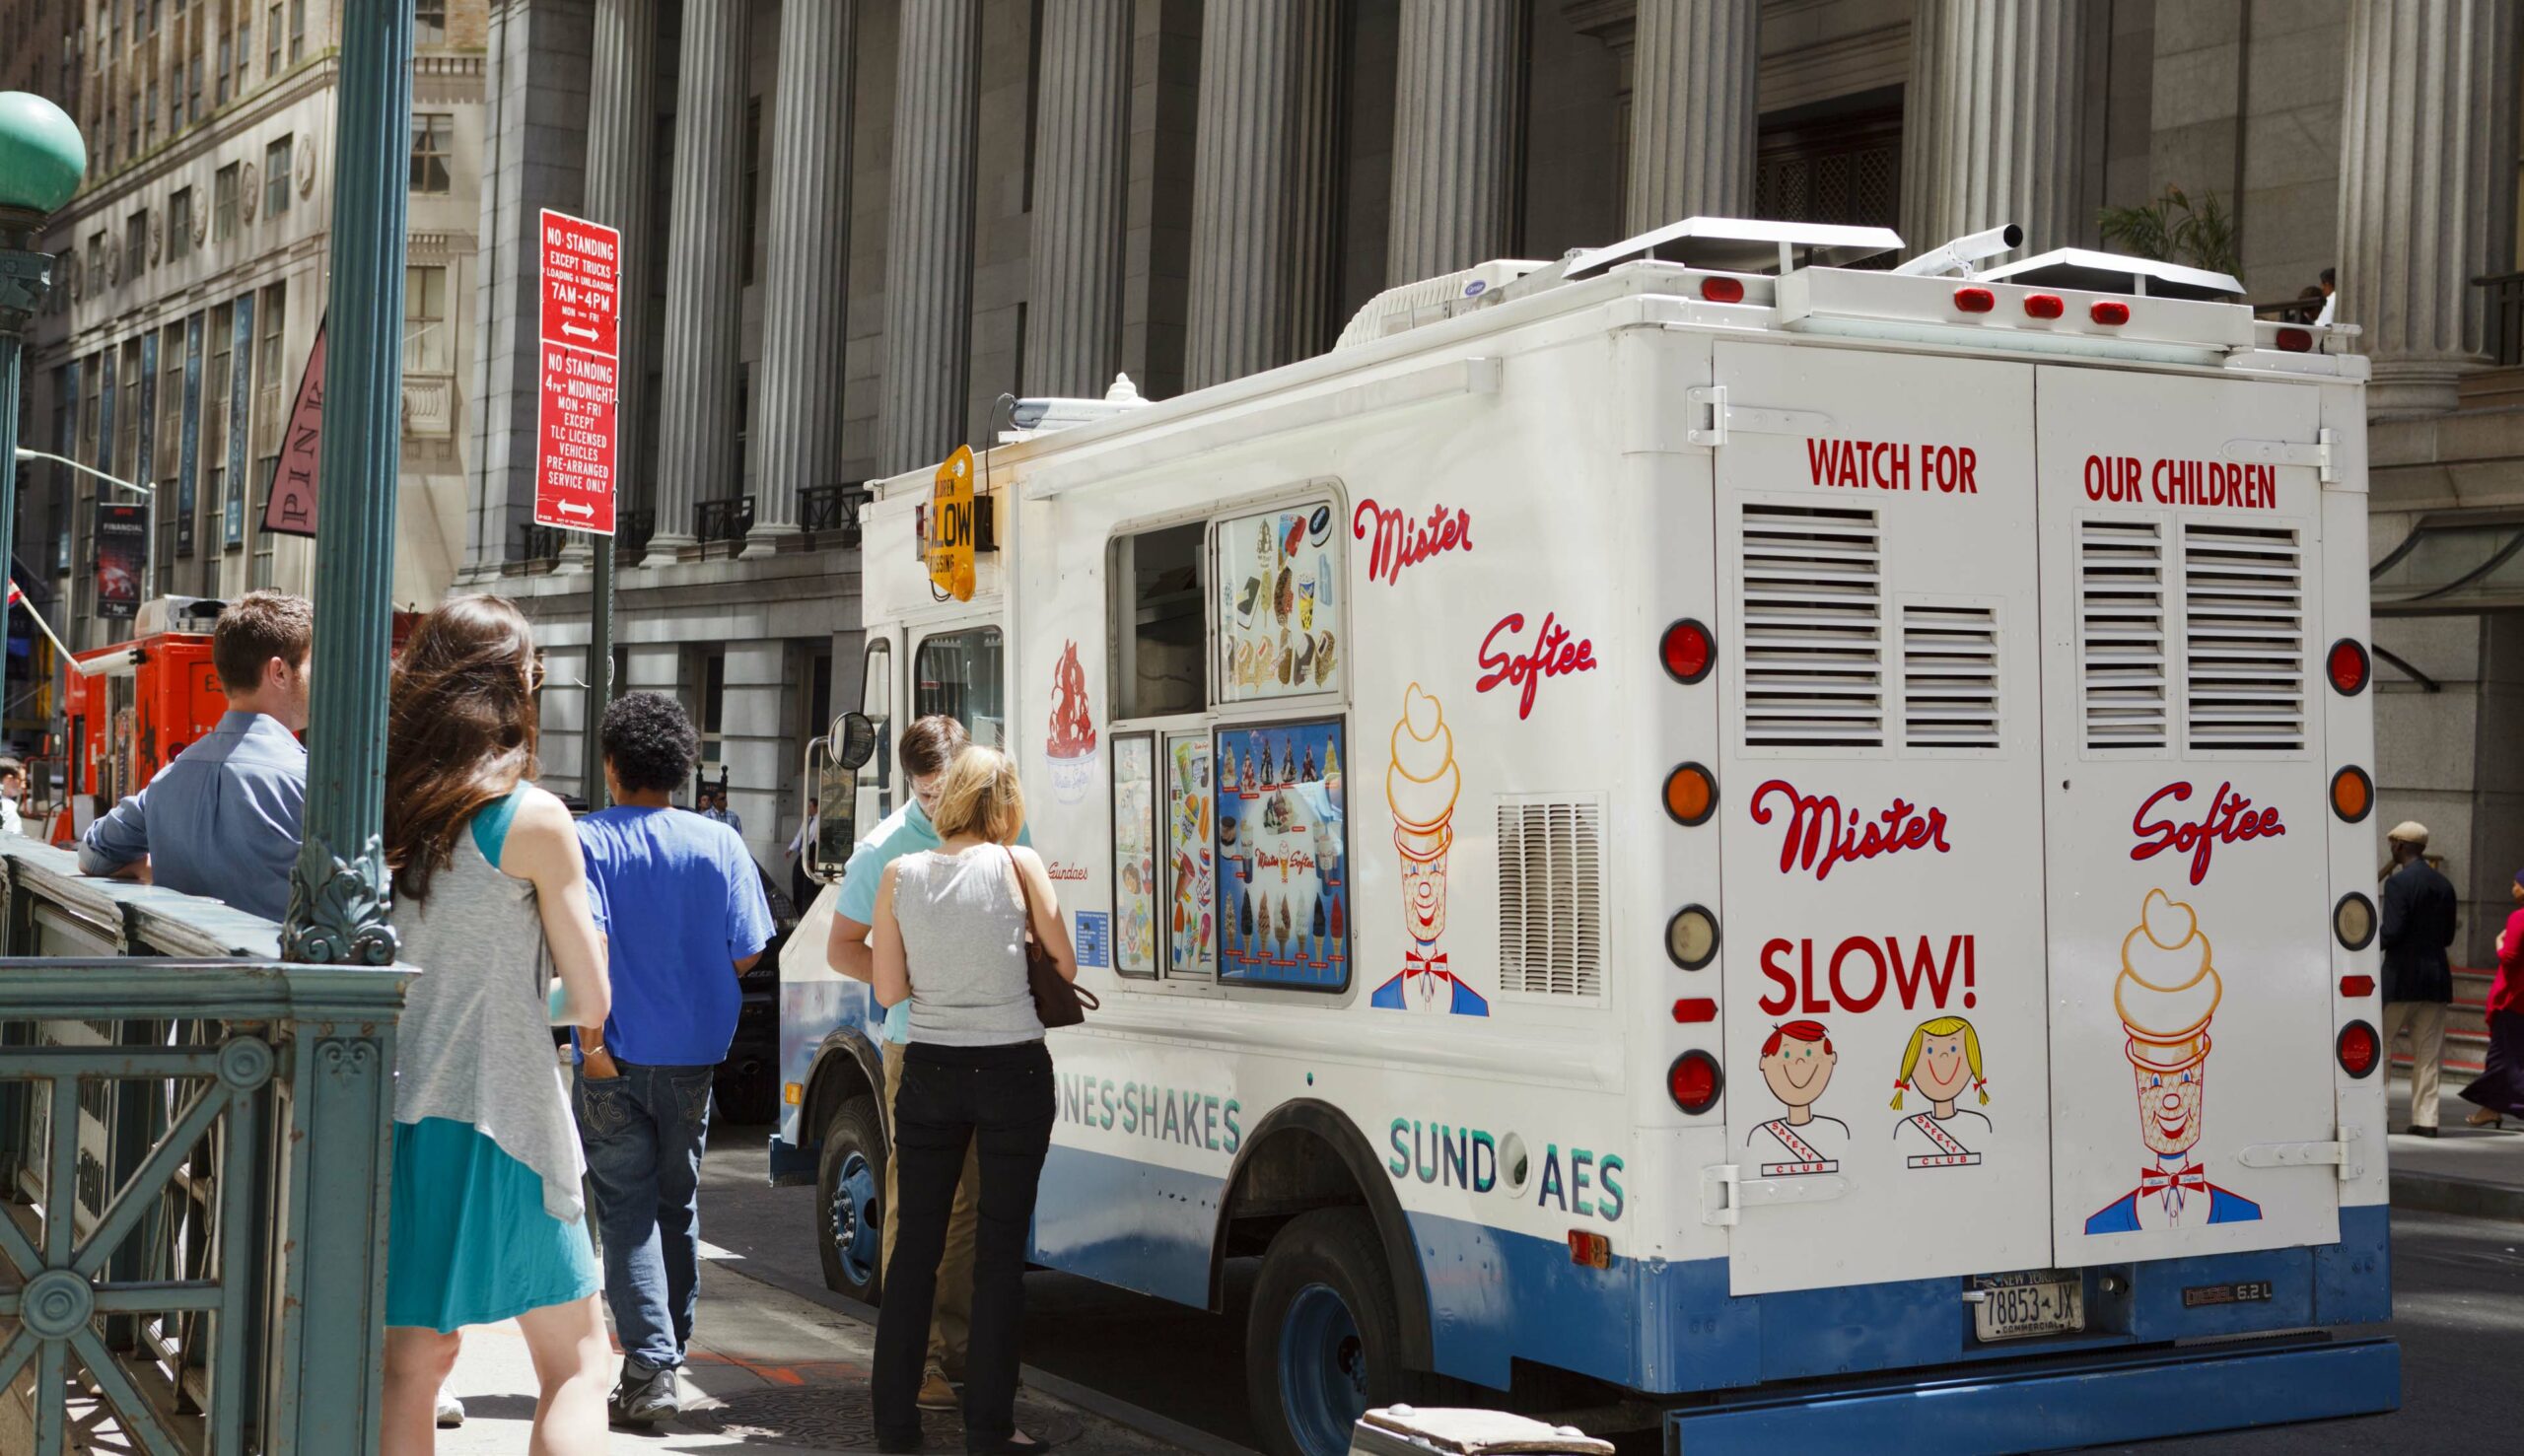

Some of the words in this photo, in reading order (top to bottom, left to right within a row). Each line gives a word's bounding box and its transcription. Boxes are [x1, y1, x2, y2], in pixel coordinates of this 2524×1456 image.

[547, 227, 561, 246] NO
[566, 233, 613, 260] STANDING
[550, 250, 580, 270] EXCEPT
[582, 259, 610, 278] TRUCKS
[547, 267, 573, 282] LOADING
[581, 276, 614, 293] UNLOADING
[562, 306, 576, 317] MON
[589, 312, 599, 322] FRI
[548, 353, 562, 372] NO
[566, 357, 612, 383] STANDING
[558, 395, 578, 412] MON
[587, 402, 600, 417] FRI
[564, 412, 595, 431] EXCEPT
[551, 425, 566, 440] TLC
[569, 429, 606, 449] LICENSED
[281, 381, 322, 525] PINK
[559, 442, 598, 461] VEHICLES
[546, 454, 608, 479] PRE-ARRANGED
[1806, 438, 1910, 491] WATCH
[1921, 445, 1979, 494] FOR
[548, 471, 583, 489] SERVICE
[586, 478, 606, 493] ONLY
[2084, 454, 2143, 503] OUR
[2151, 458, 2276, 509] CHILDREN
[104, 522, 143, 532] FINANCIAL
[1354, 499, 1472, 587] Mister
[1476, 611, 1597, 721] Softee
[1750, 779, 1951, 881] Mister
[2130, 781, 2285, 886] Softee
[1758, 935, 1978, 1016] SLOW!
[1772, 1122, 1812, 1160] SAFETY
[1918, 1115, 1957, 1152] SAFETY
[1776, 1162, 1823, 1174] CLUB
[1922, 1155, 1967, 1165] CLUB
[2000, 1272, 2024, 1286] NEW
[2026, 1270, 2055, 1285] YORK
[2002, 1322, 2059, 1334] COMMERCIAL
